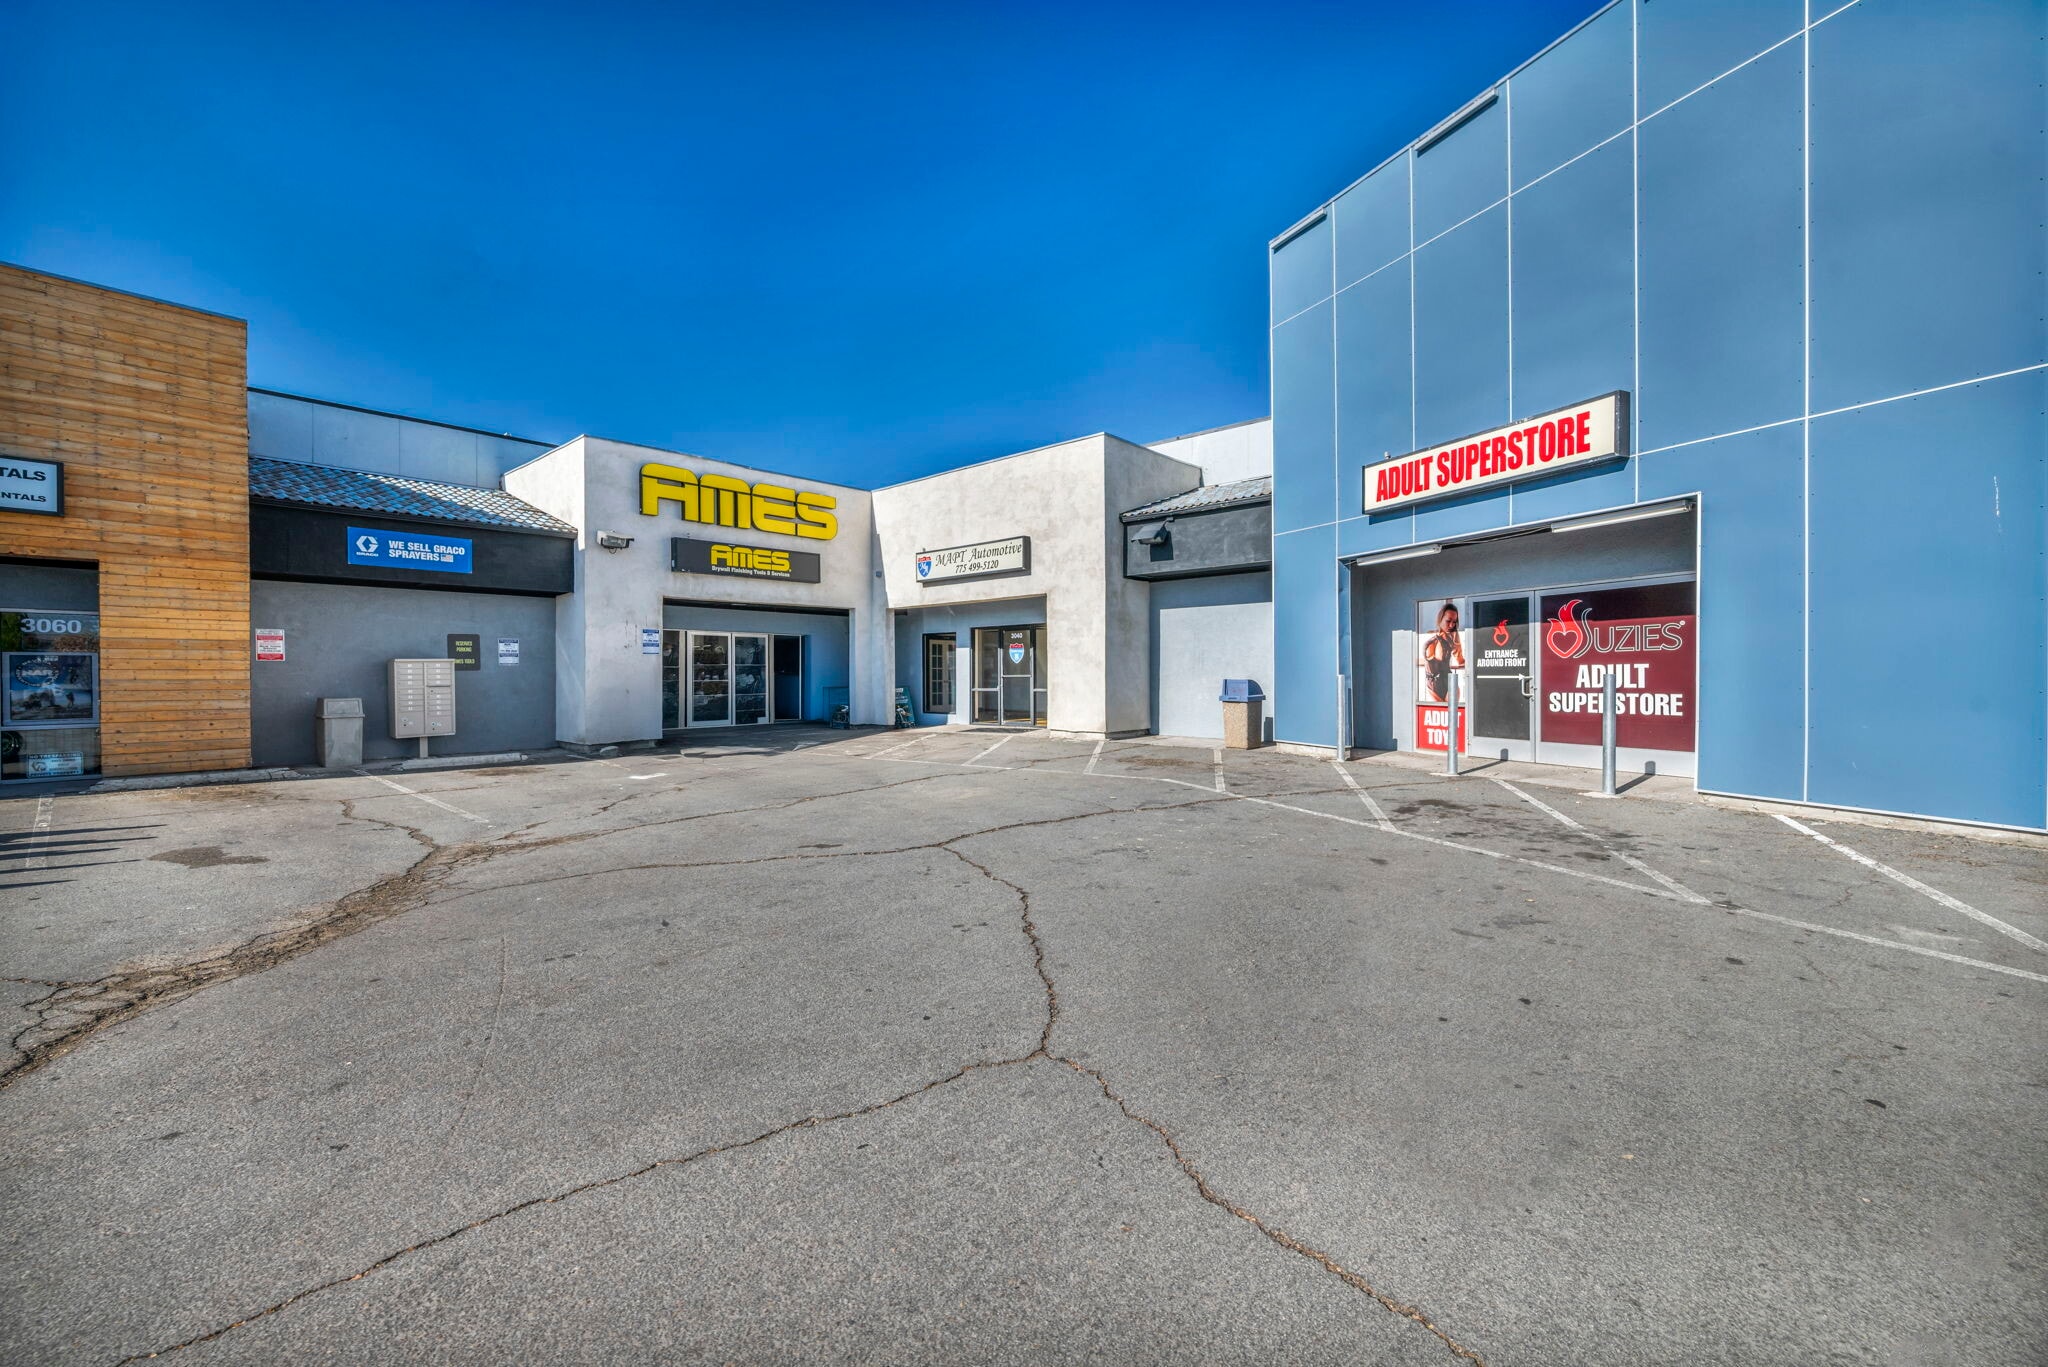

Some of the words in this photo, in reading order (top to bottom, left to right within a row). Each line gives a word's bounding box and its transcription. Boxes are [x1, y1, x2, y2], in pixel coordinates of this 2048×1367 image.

[1376, 455, 1434, 502] ADULT
[1437, 411, 1591, 487] SUPERSTORE
[640, 462, 838, 541] AMES
[388, 540, 405, 550] WE
[407, 541, 431, 552] SELL
[433, 544, 465, 556] GRACO
[388, 549, 440, 562] SPRAYERS
[935, 549, 968, 567] MAPT
[968, 541, 1022, 562] Automotive
[711, 544, 790, 572] AMES
[955, 564, 967, 574] 775
[968, 559, 999, 571] 499-5120
[731, 567, 753, 575] Finishing
[20, 618, 82, 634] 3060
[1573, 607, 1683, 659] SUZIES
[1477, 658, 1504, 668] AROUND
[1504, 657, 1527, 667] FRONT
[1484, 649, 1518, 659] ENTRANCE
[1576, 663, 1650, 689] ADULT
[1426, 728, 1450, 746] TOY
